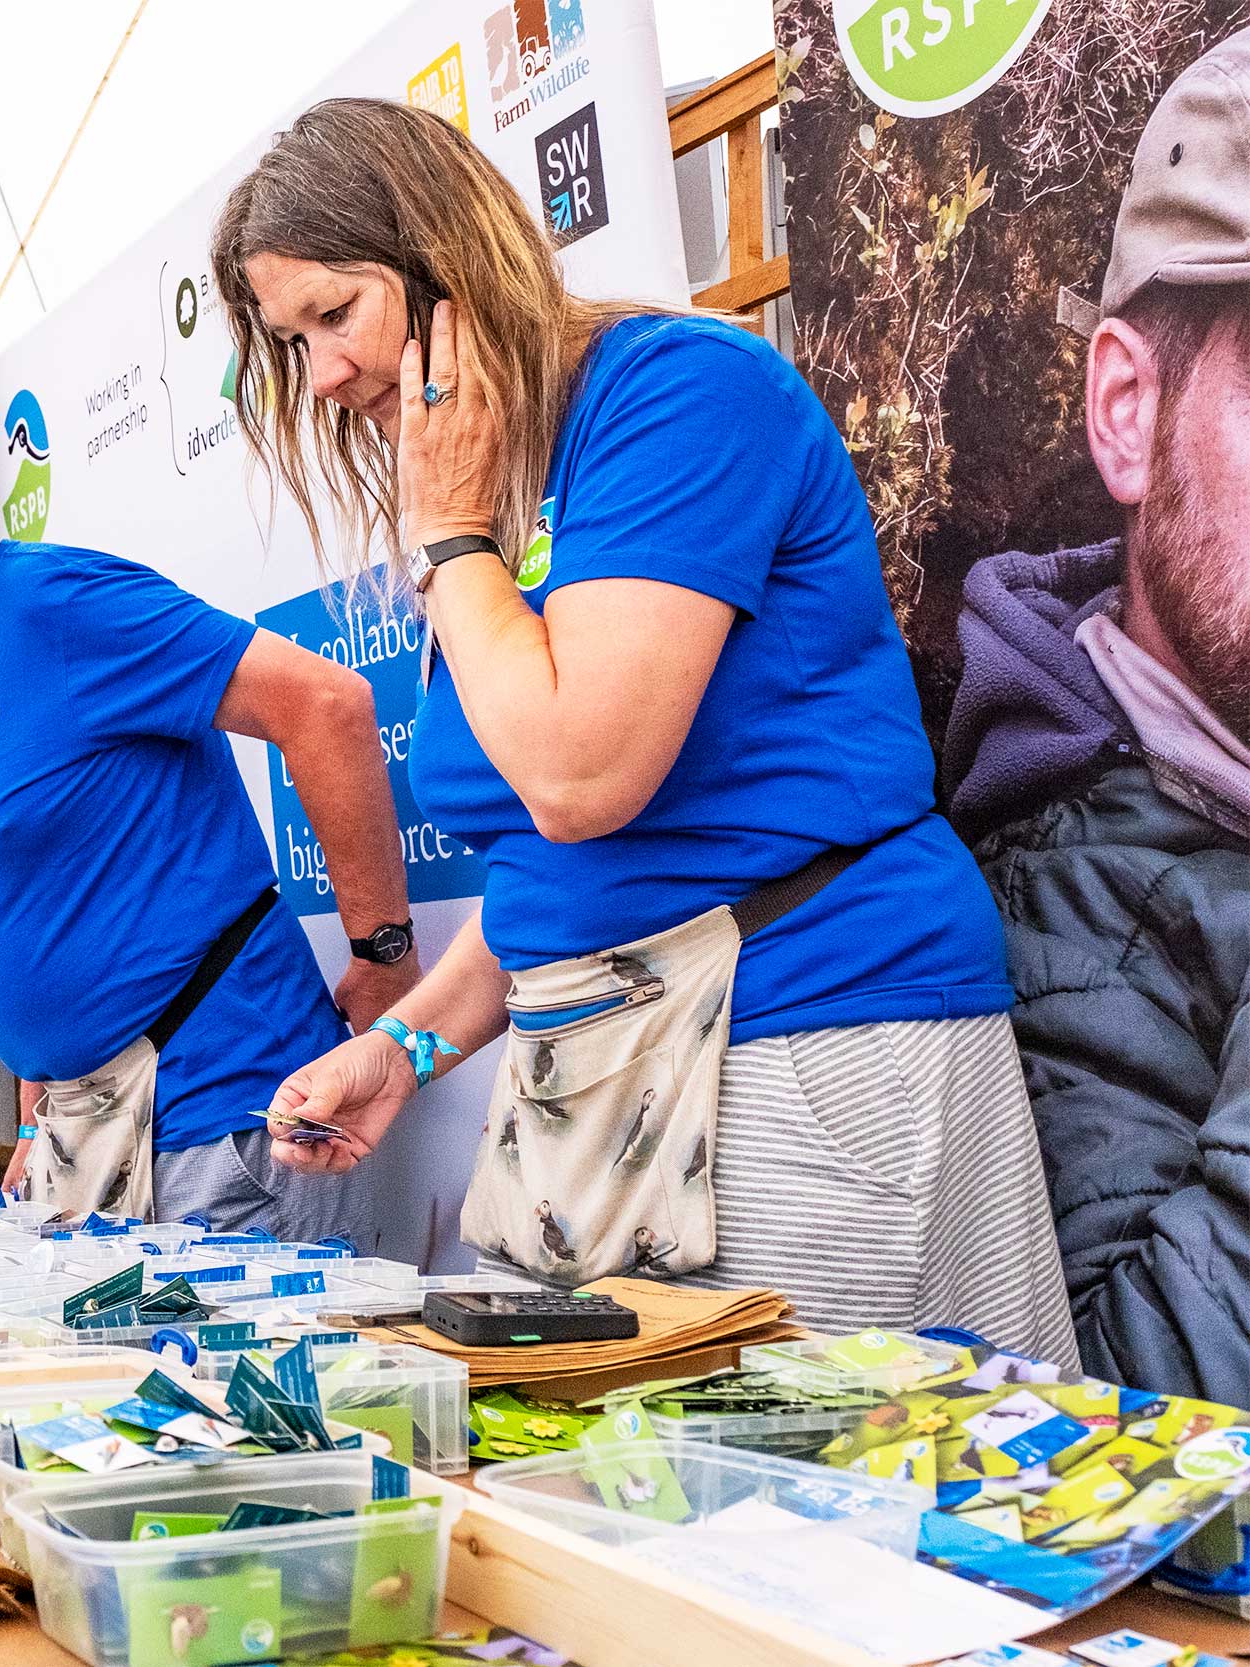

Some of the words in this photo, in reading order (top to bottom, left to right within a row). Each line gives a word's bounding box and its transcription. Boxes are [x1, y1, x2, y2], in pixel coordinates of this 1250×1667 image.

[441, 55, 461, 92] TO
[546, 122, 590, 187] SW
[86, 372, 130, 417] Working
[130, 362, 142, 388] in
[87, 401, 148, 467] partnership
[187, 409, 237, 461] idverde
[9, 485, 47, 536] RSPB
